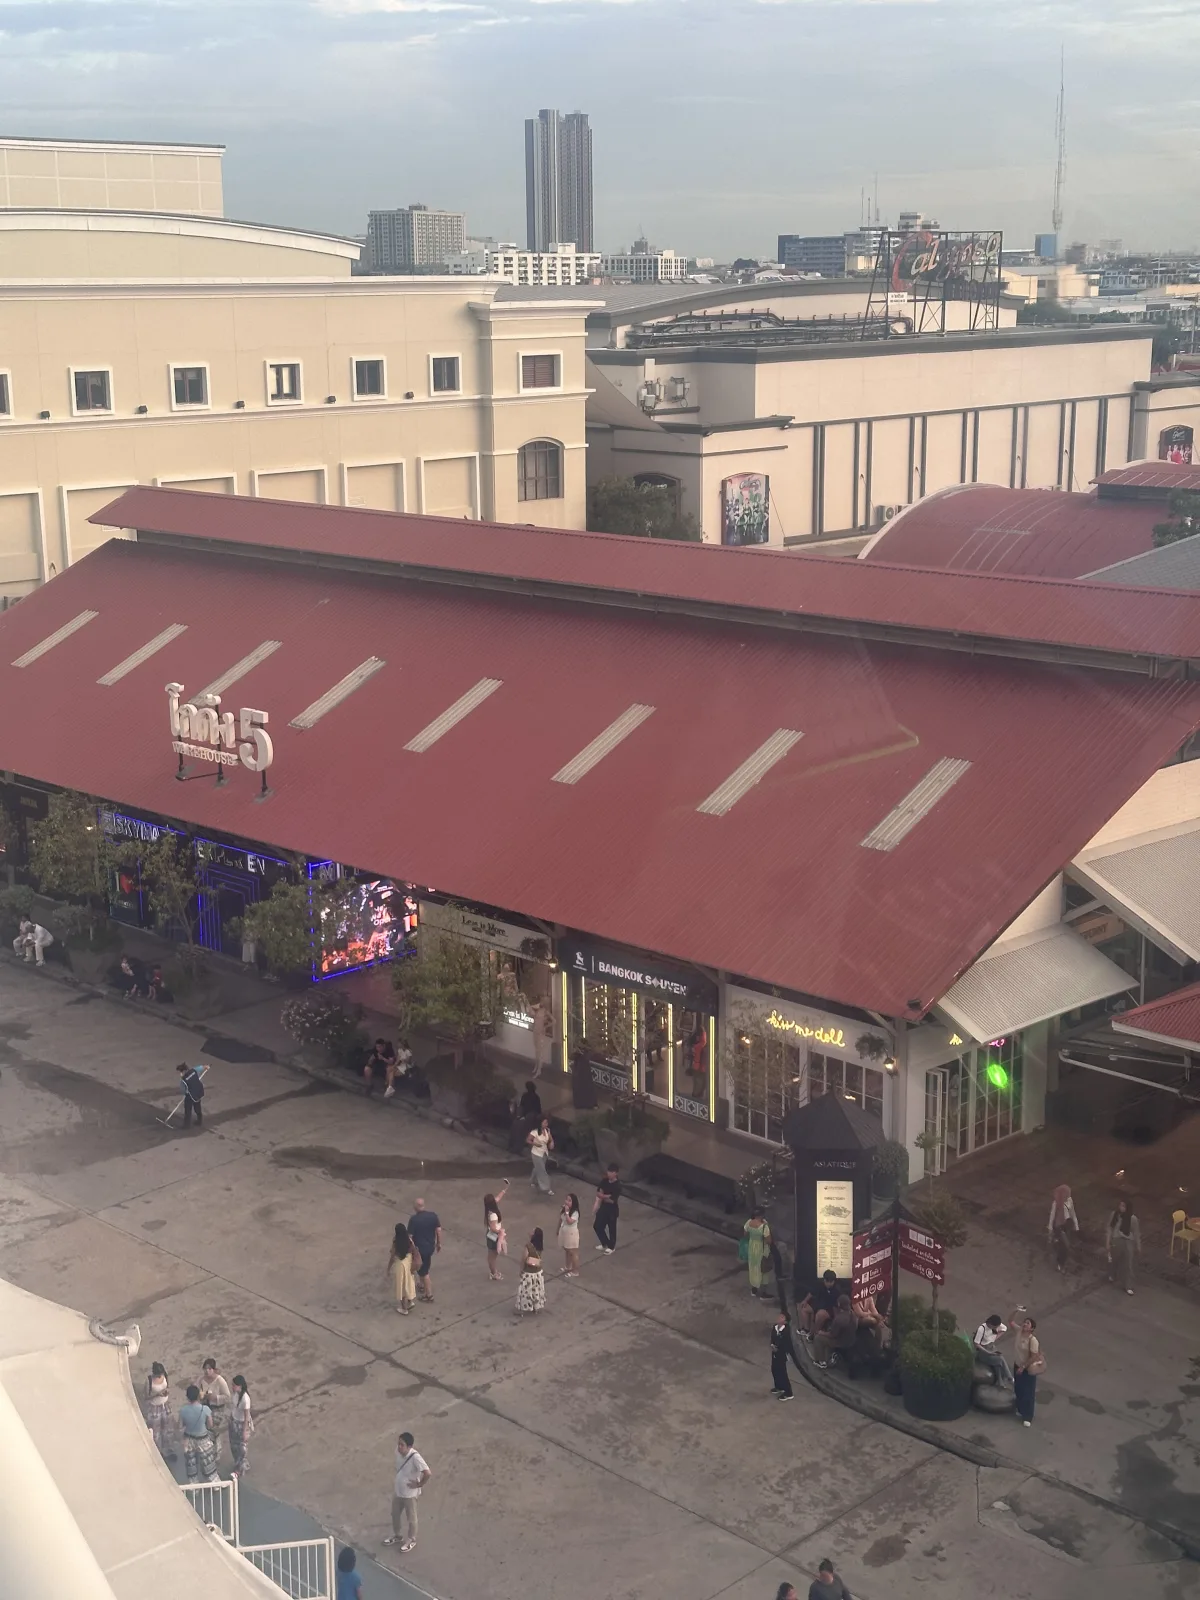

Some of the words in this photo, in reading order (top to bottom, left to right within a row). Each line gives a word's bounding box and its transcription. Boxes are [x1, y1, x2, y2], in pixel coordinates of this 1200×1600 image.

[891, 231, 1002, 292] Calypso
[239, 707, 274, 772] 5
[172, 740, 239, 767] WAREHOUSE
[598, 961, 643, 984] BANGKOK
[795, 1024, 814, 1038] me
[815, 1027, 846, 1048] doll
